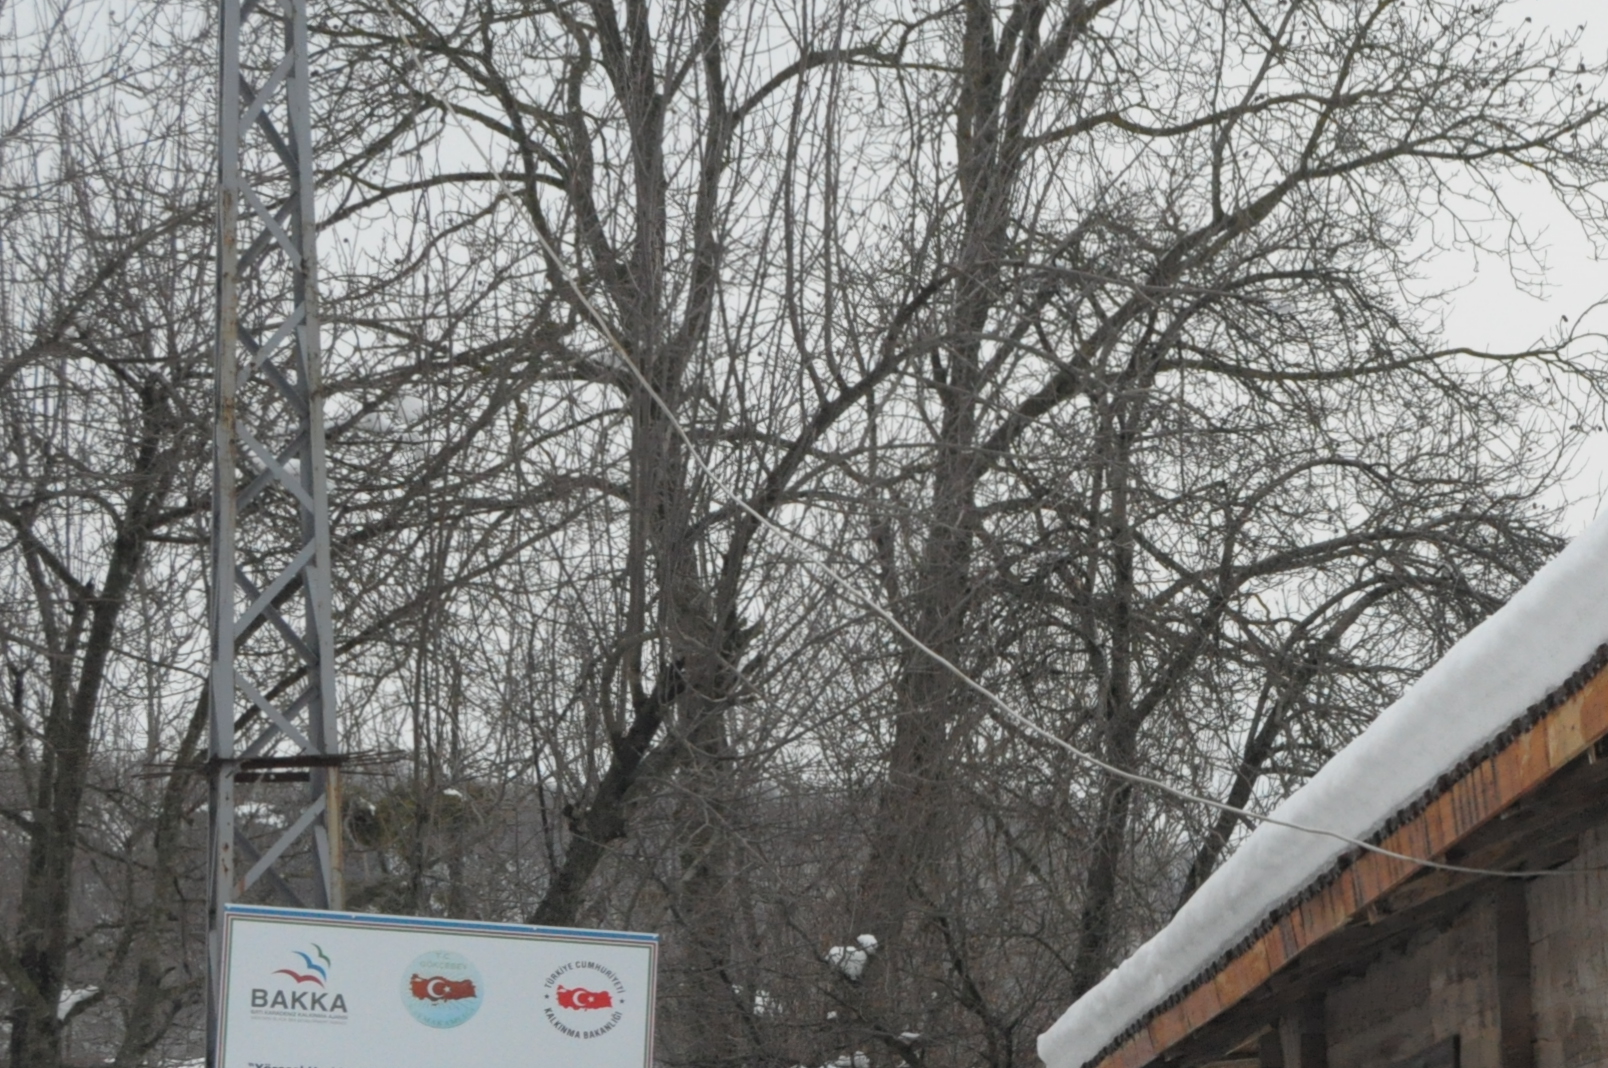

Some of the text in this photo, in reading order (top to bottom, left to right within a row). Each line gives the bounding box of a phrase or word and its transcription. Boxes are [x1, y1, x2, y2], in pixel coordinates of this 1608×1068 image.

[544, 960, 626, 993] TÜRKİYE CUMHURİYETİ
[251, 988, 348, 1013] BAKKA
[544, 1007, 623, 1039] KALKINMA BAKANLIĞI
